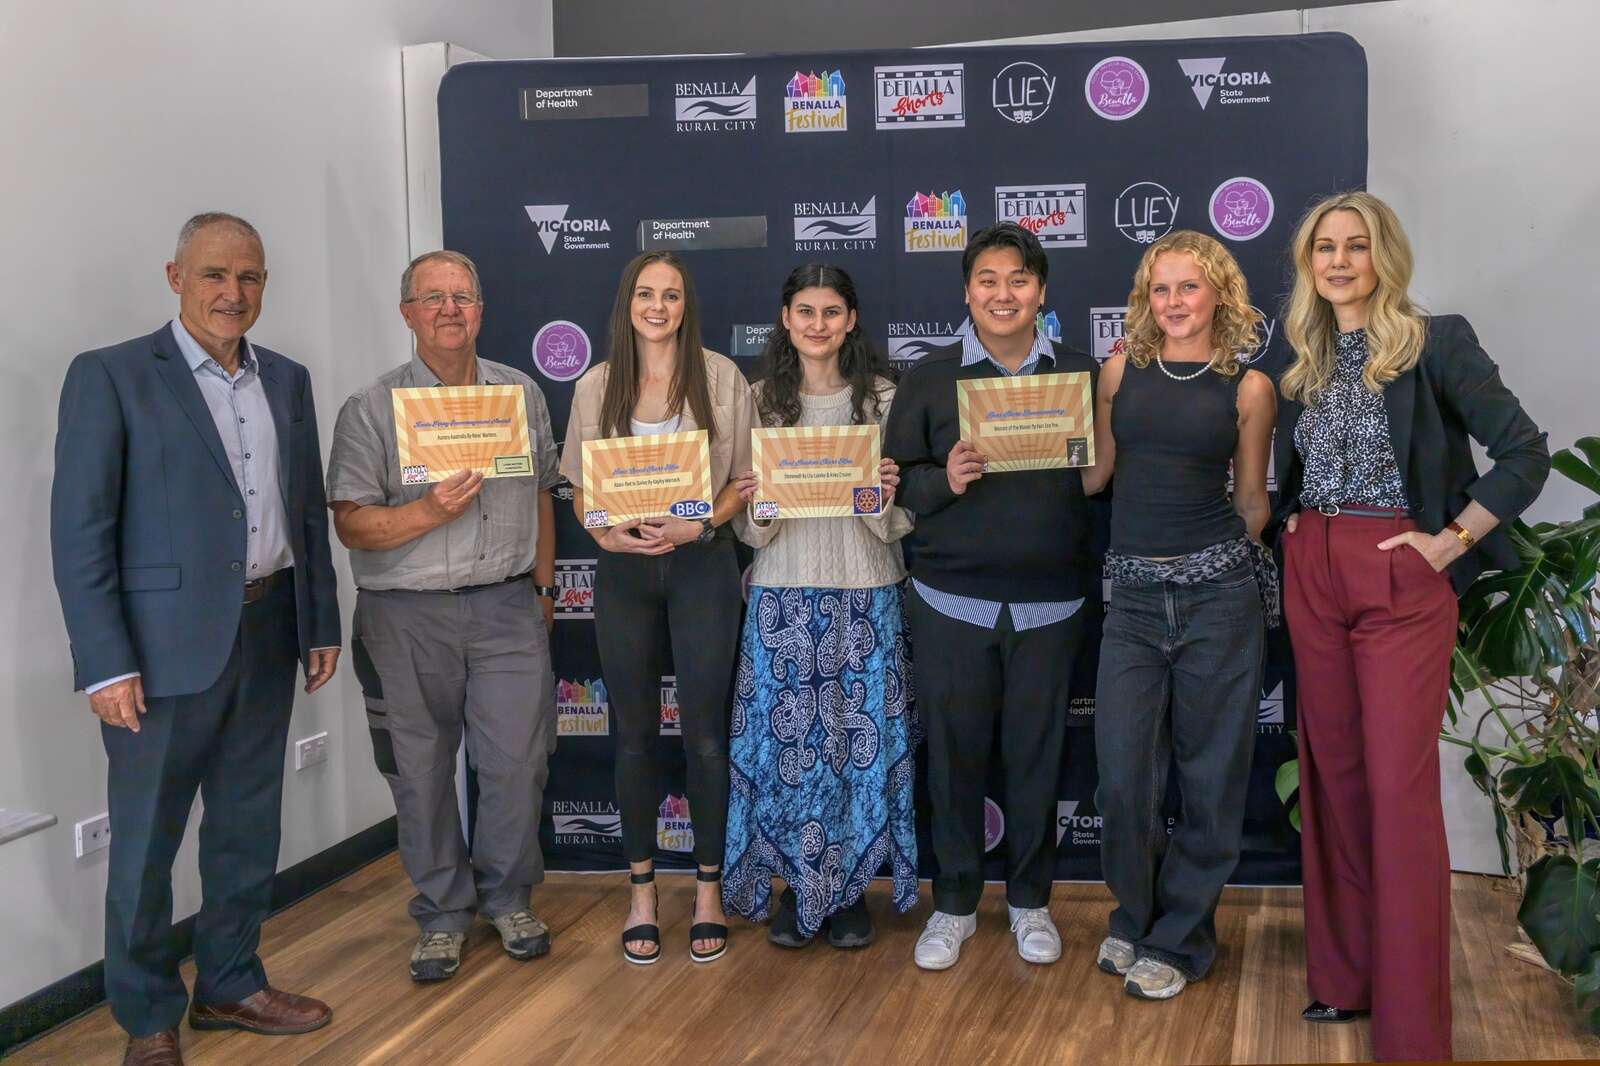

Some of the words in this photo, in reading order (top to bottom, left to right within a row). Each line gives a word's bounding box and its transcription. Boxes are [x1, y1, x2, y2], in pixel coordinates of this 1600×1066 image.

[1187, 71, 1272, 87] VICTORIA
[535, 87, 593, 99] Department
[675, 81, 741, 96] BENALLA
[883, 79, 955, 97] BENALLA
[992, 76, 1057, 108] LUEY
[1220, 89, 1243, 97] State
[535, 99, 545, 109] of
[547, 98, 578, 109] Health
[792, 100, 841, 110] BENALLA
[891, 90, 945, 116] Shorts
[1220, 95, 1271, 105] Government
[786, 106, 845, 131] Festival
[676, 122, 720, 132] RURAL
[724, 120, 757, 131] CITY
[794, 201, 860, 216] BENALLA
[1004, 199, 1077, 217] BENALLA
[1115, 196, 1180, 228] LUEY
[533, 218, 611, 233] VICTORIA
[652, 219, 711, 232] Department
[912, 219, 962, 230] BENALLA
[563, 235, 585, 243] State
[652, 231, 662, 240] of
[664, 229, 696, 240] Health
[905, 226, 965, 251] Festival
[563, 242, 610, 250] Government
[795, 241, 839, 252] RURAL
[844, 240, 877, 250] CITY
[887, 322, 954, 336] BENALLA
[745, 335, 756, 345] of
[676, 502, 706, 516] BBC
[557, 705, 604, 715] BENALLA
[559, 713, 608, 733] estival
[552, 800, 615, 814] BENALLA
[1058, 815, 1104, 829] CTOR
[554, 834, 597, 845] RURAL
[1072, 830, 1095, 838] State
